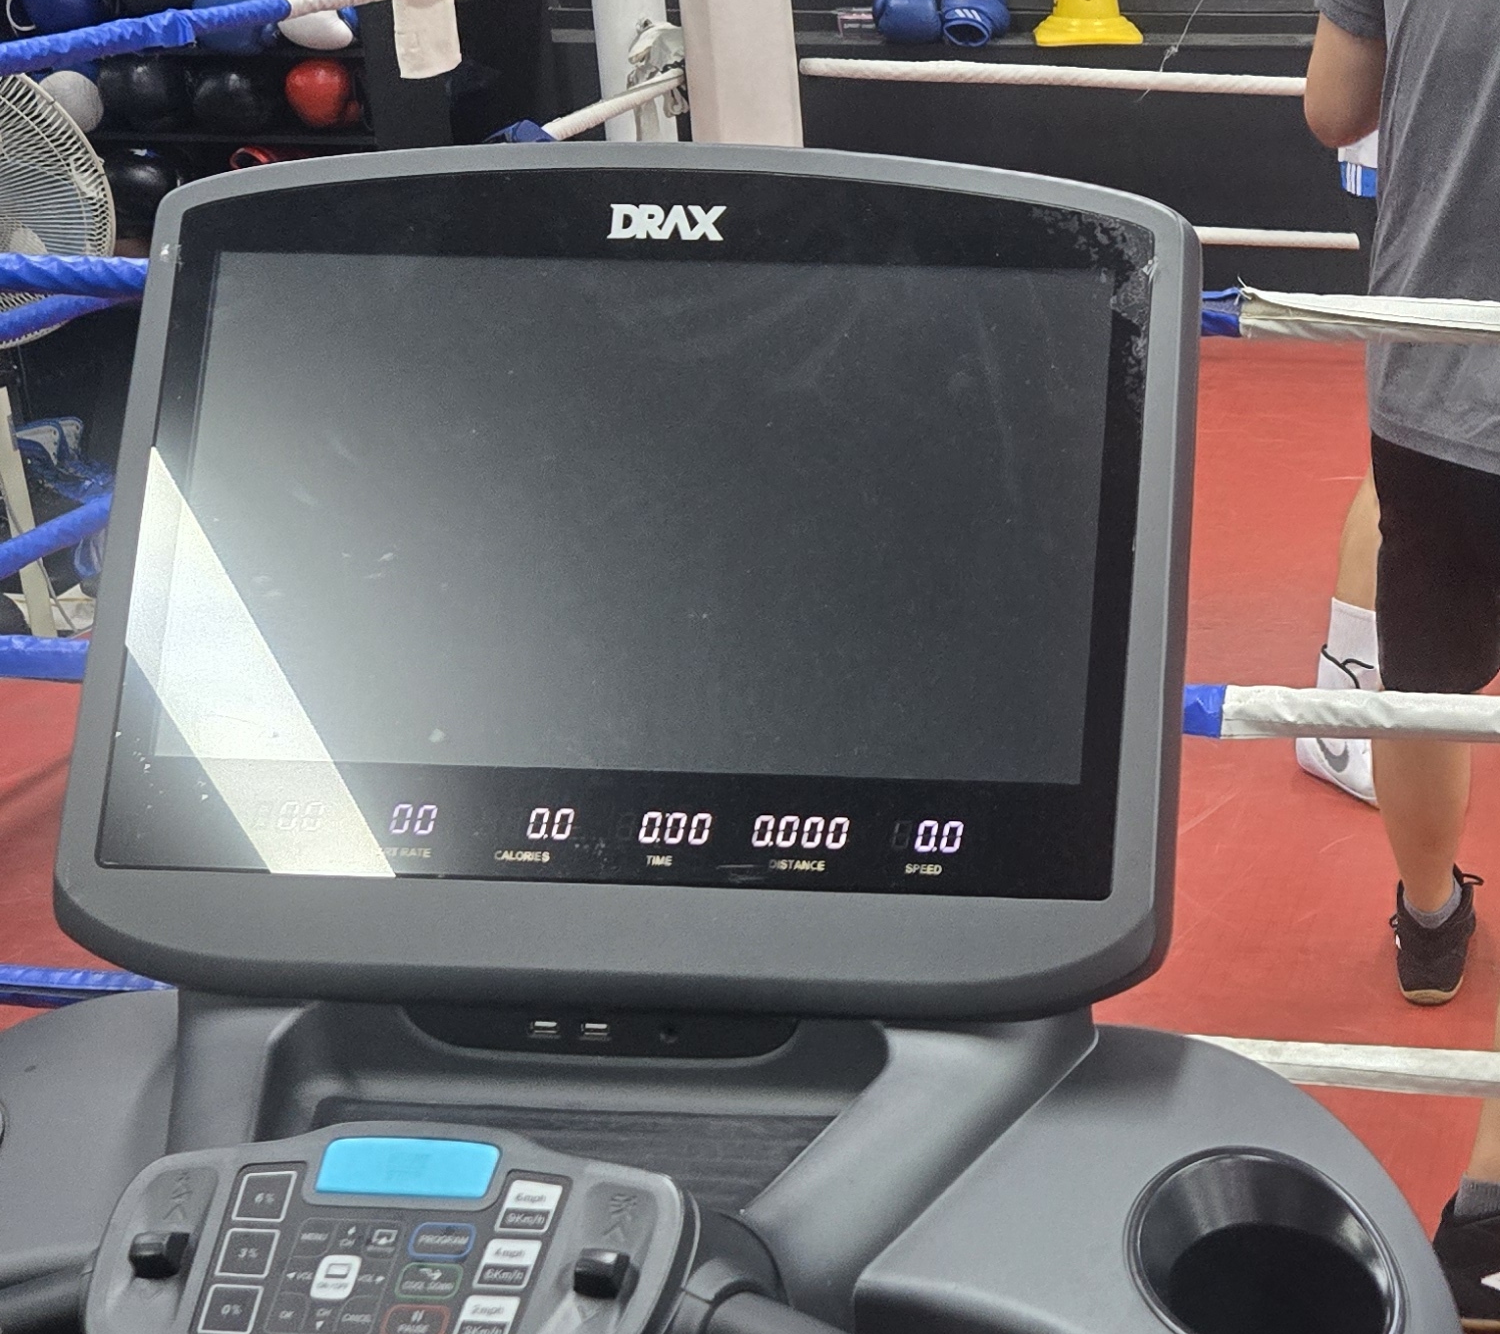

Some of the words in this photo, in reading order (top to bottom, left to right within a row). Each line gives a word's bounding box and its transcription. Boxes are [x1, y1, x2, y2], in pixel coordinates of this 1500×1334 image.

[606, 203, 728, 241] DRAX
[494, 849, 551, 863] CALORIES
[646, 854, 673, 867] TIME
[768, 858, 826, 873] DISTANCE
[905, 862, 943, 876] SPEED
